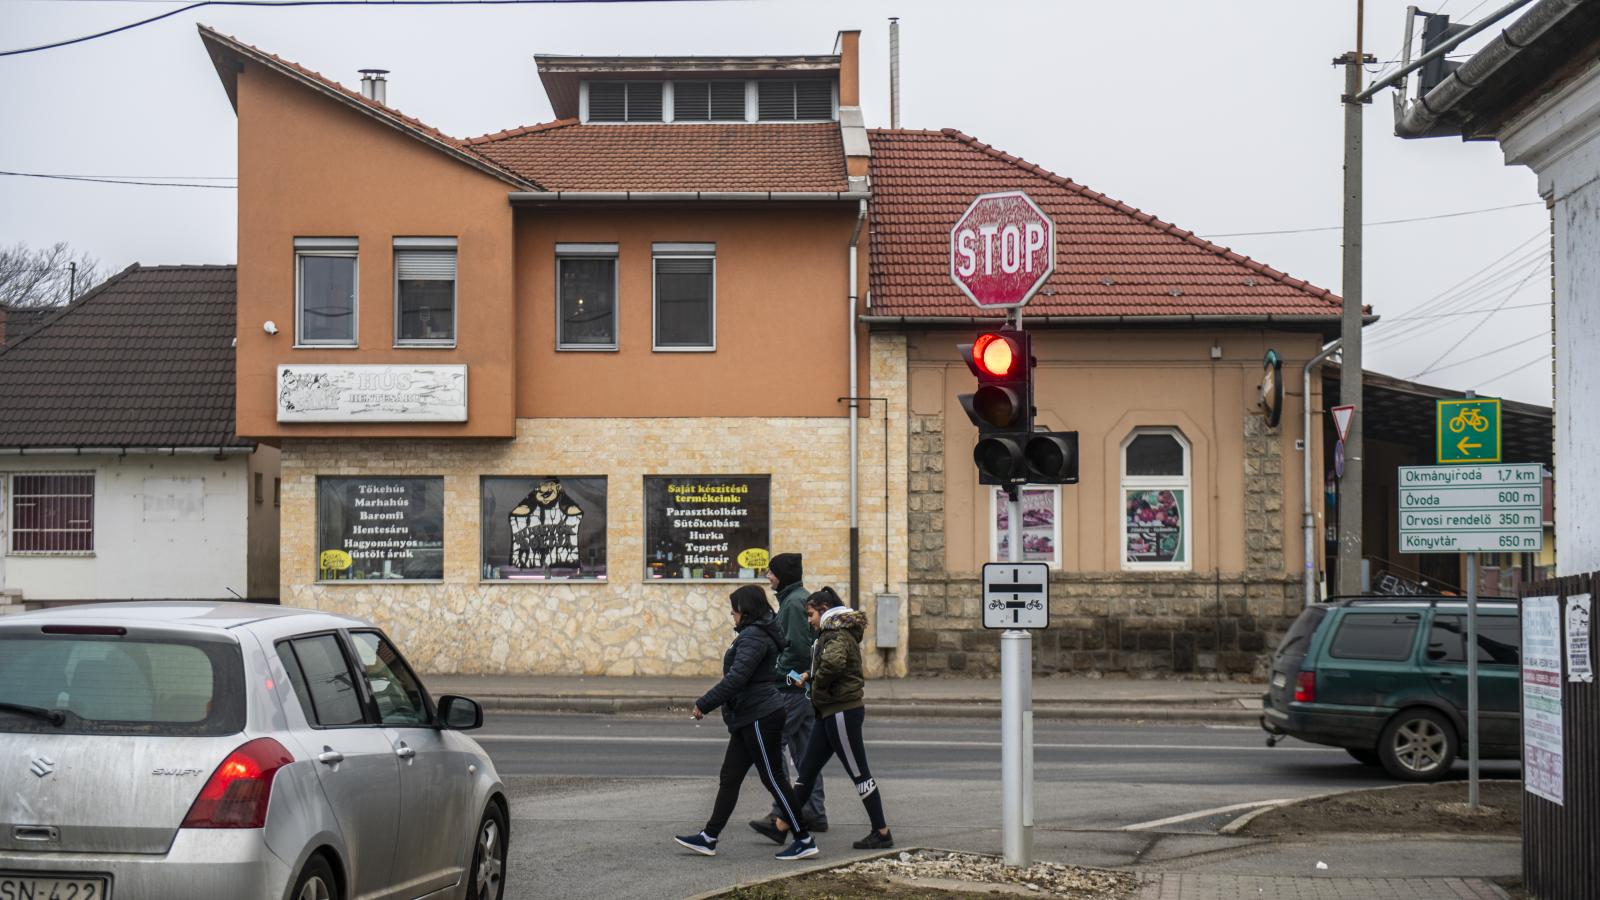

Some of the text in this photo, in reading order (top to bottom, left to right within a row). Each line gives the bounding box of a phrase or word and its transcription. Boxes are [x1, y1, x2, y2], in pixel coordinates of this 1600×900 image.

[958, 223, 1045, 277] STOP
[359, 367, 412, 391] HÚS
[1405, 469, 1535, 483] Okmányiroda 1,7 km
[359, 484, 405, 494] Tőkehús
[668, 484, 695, 495] Saját
[354, 497, 409, 507] Marhahús
[675, 495, 741, 503] termékeink:
[1406, 491, 1535, 506] Óvoda 600 m
[360, 511, 404, 521] Baromfi
[666, 506, 748, 516] Parasztkolbász
[673, 518, 740, 528] Sütőkolbász
[1406, 515, 1442, 526] Orvosi
[1499, 513, 1520, 525] 350
[1523, 515, 1535, 525] m
[352, 524, 409, 535] Hentesáru
[689, 531, 724, 540] Hurka
[1406, 535, 1536, 549] Könyvtár 650 m
[686, 543, 728, 553] Tepertő
[349, 549, 414, 559] füstölt áruk
[151, 767, 203, 777] SWIFT
